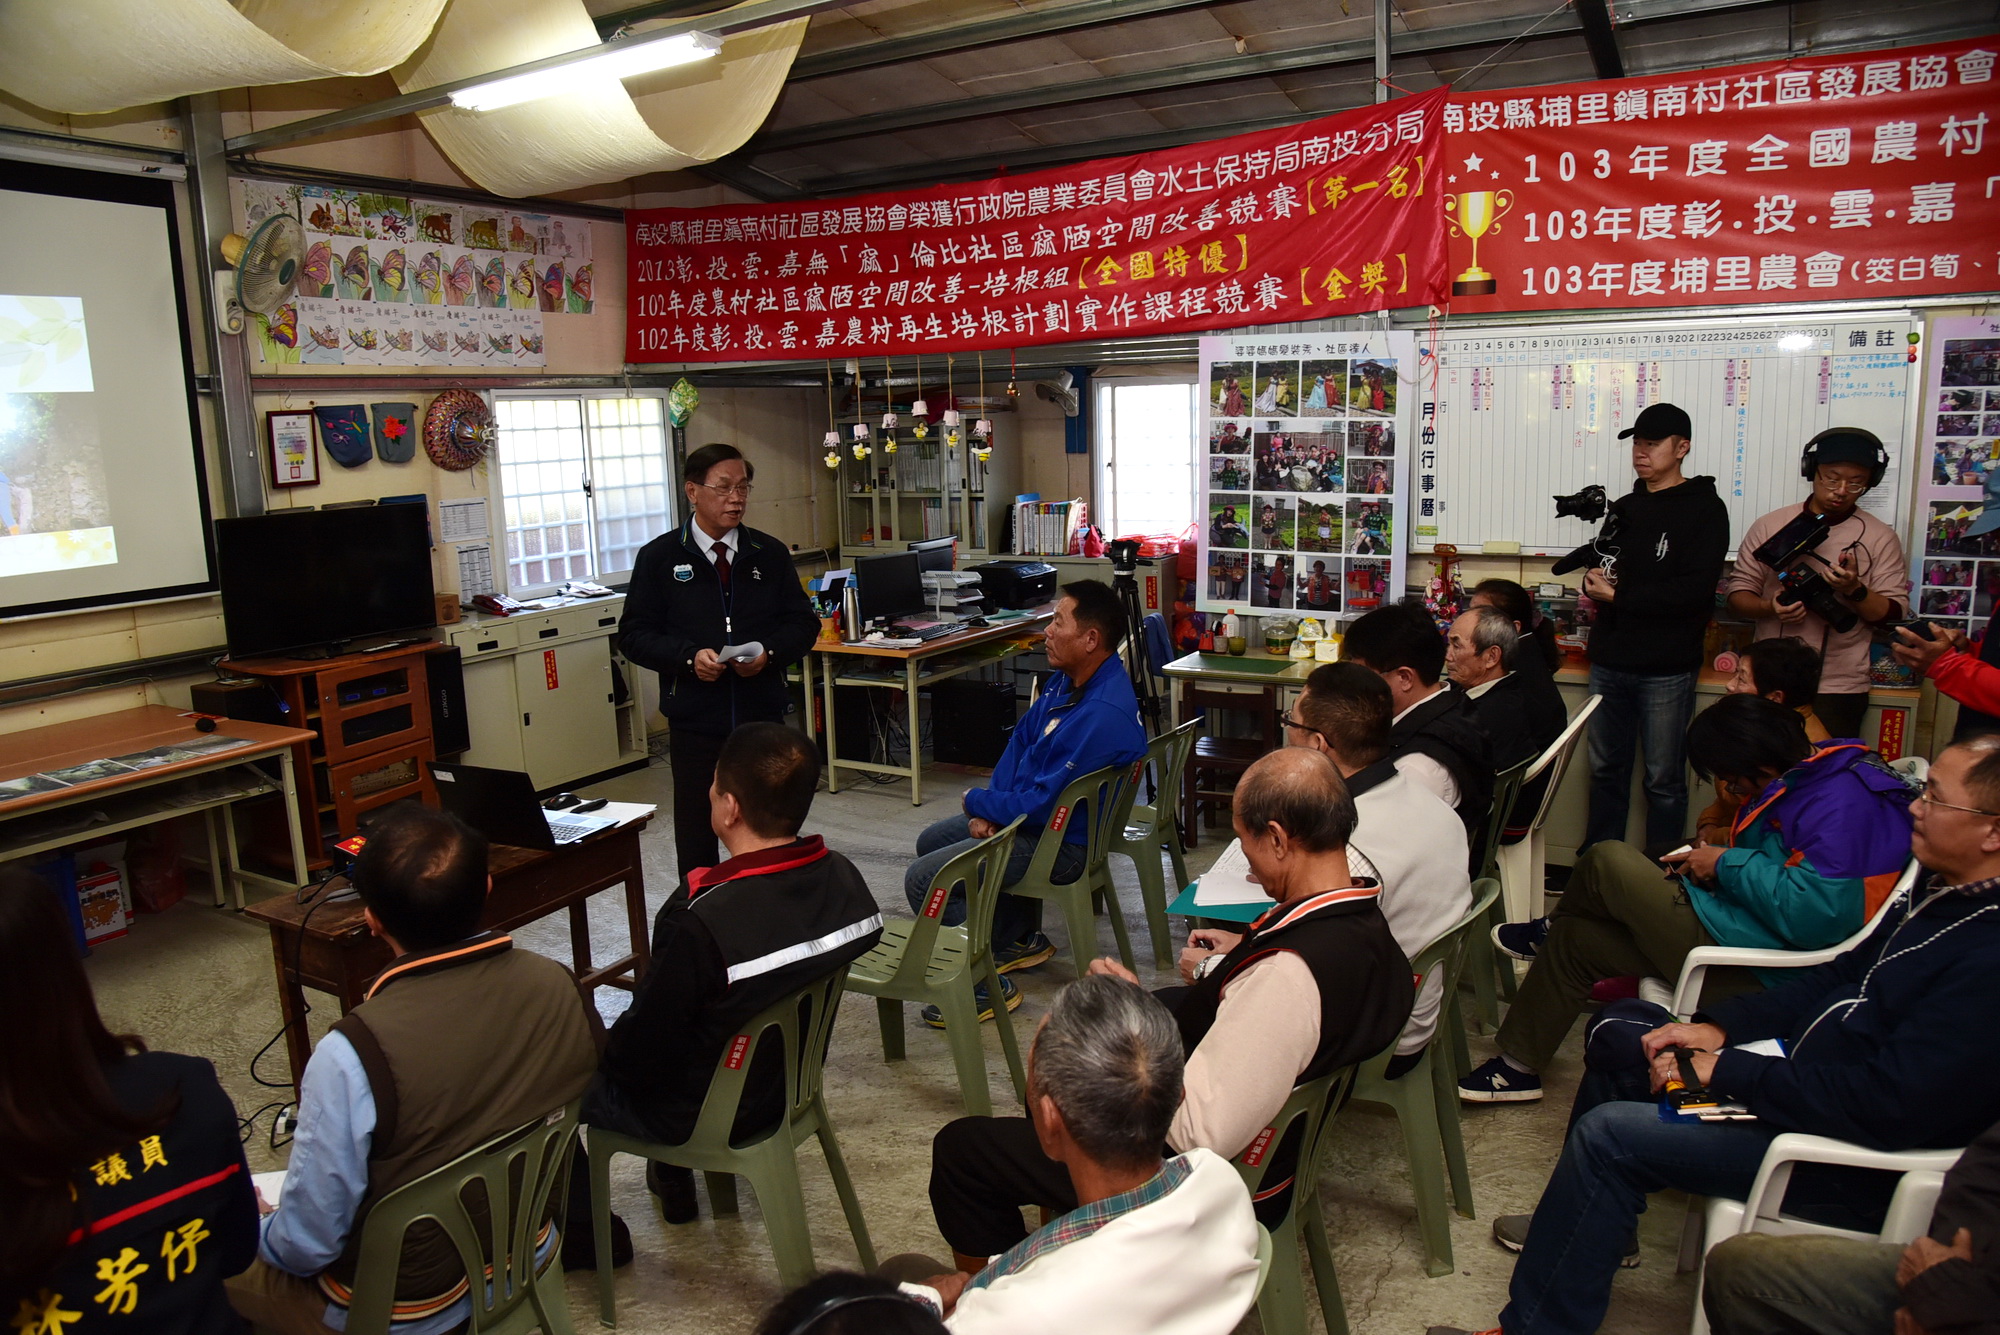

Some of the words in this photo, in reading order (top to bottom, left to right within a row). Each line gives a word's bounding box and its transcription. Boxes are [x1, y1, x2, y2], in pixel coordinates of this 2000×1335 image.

[1443, 49, 1998, 134] 南投縣埔里鎮南村社區發展協會
[1524, 112, 1989, 184] 103年度全國農村
[1522, 250, 2000, 297] 103年度埔里農會(筊白筍、
[1463, 343, 1469, 351] 2
[1474, 342, 1480, 350] 3
[1497, 341, 1503, 349] 5
[1508, 341, 1515, 349] 6
[1531, 340, 1538, 348] 8
[1543, 339, 1550, 347] 9
[1553, 339, 1563, 347] 10
[1566, 339, 1575, 347] 11
[1577, 338, 1587, 346] 12
[1589, 338, 1599, 346] 13
[1601, 337, 1611, 345] 14
[1613, 336, 1624, 345] 15
[1626, 336, 1636, 344] 16
[1638, 335, 1648, 344] 17
[1650, 335, 1661, 344] 18
[1663, 334, 1674, 343] 19
[1675, 334, 1688, 343] 20
[1688, 334, 1700, 342] 21
[1700, 333, 1713, 342] 22
[1713, 332, 1726, 341] 23
[1726, 332, 1739, 340] 24
[1739, 332, 1752, 340] 25
[1753, 331, 1766, 340] 26
[1766, 330, 1779, 339] 27
[1807, 329, 1820, 337] 30
[1848, 329, 1896, 348] 備註
[1420, 402, 1436, 517] 月份行事曆
[88, 1134, 169, 1187] 議員
